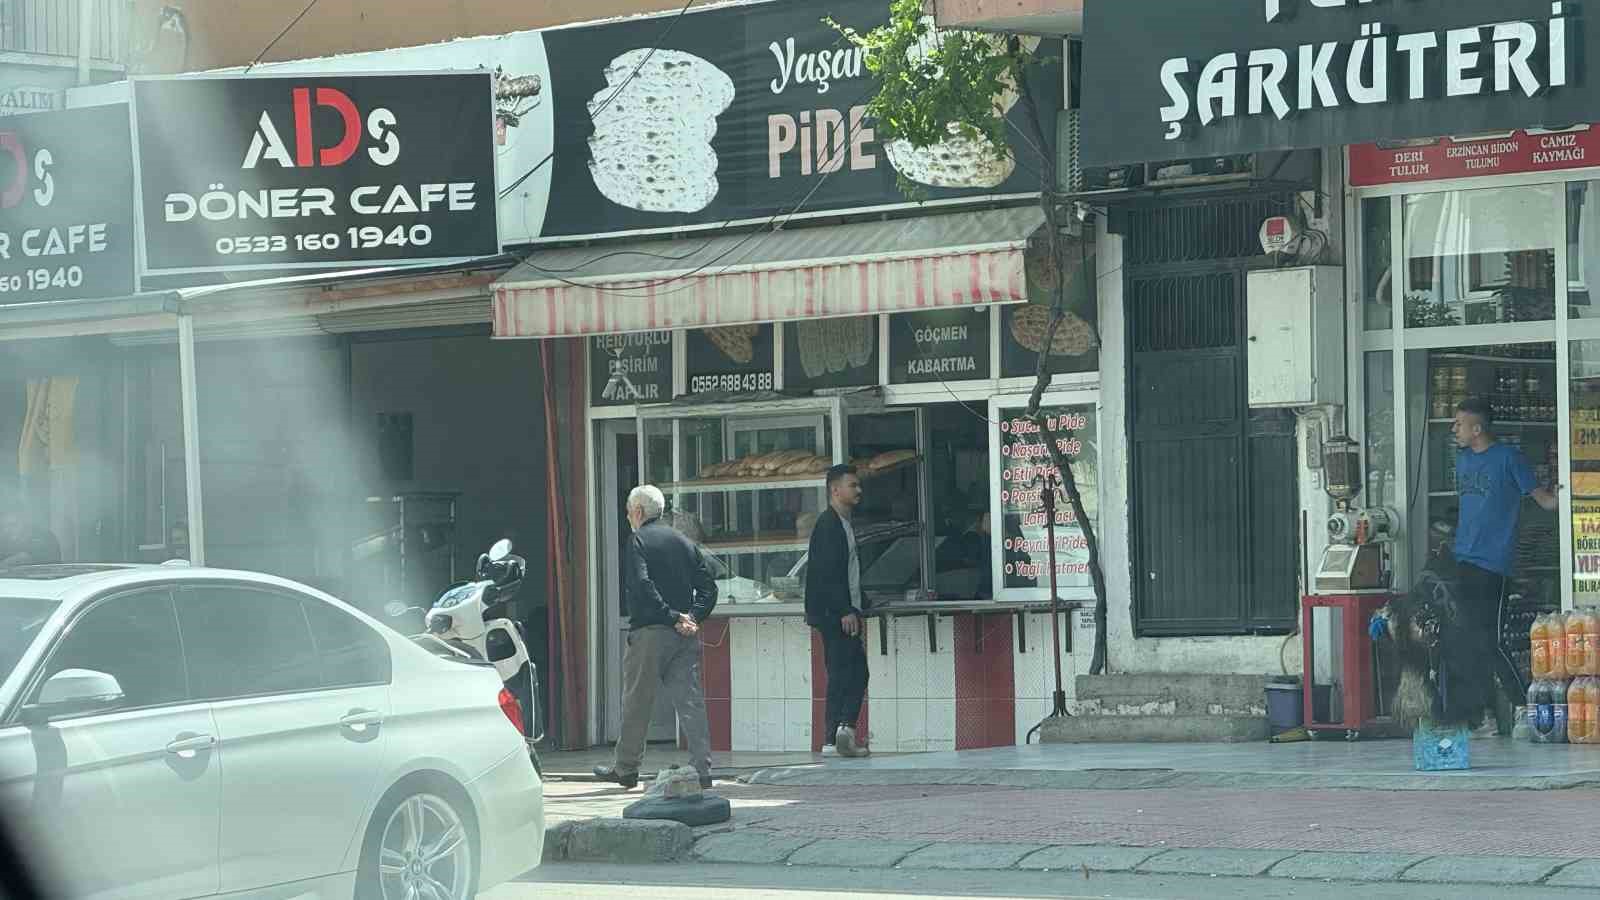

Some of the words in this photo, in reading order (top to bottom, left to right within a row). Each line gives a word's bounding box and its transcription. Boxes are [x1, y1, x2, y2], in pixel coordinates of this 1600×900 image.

[1160, 2, 1565, 139] ŞARKÜTERİ
[1540, 134, 1576, 148] CAMIZ
[1389, 164, 1429, 176] TULUM
[165, 184, 337, 222] DÖNER
[350, 182, 476, 215] CAFE
[22, 224, 107, 256] CAFE
[216, 236, 287, 254] 0533
[295, 232, 340, 251] 160
[348, 223, 432, 249] 1940
[26, 265, 82, 290] 1940
[915, 326, 967, 344] GÖÇMEN
[908, 356, 975, 374] KABARTMA
[691, 375, 718, 393] 0552
[721, 374, 741, 392] 688
[742, 373, 757, 390] 43
[758, 372, 772, 390] 88
